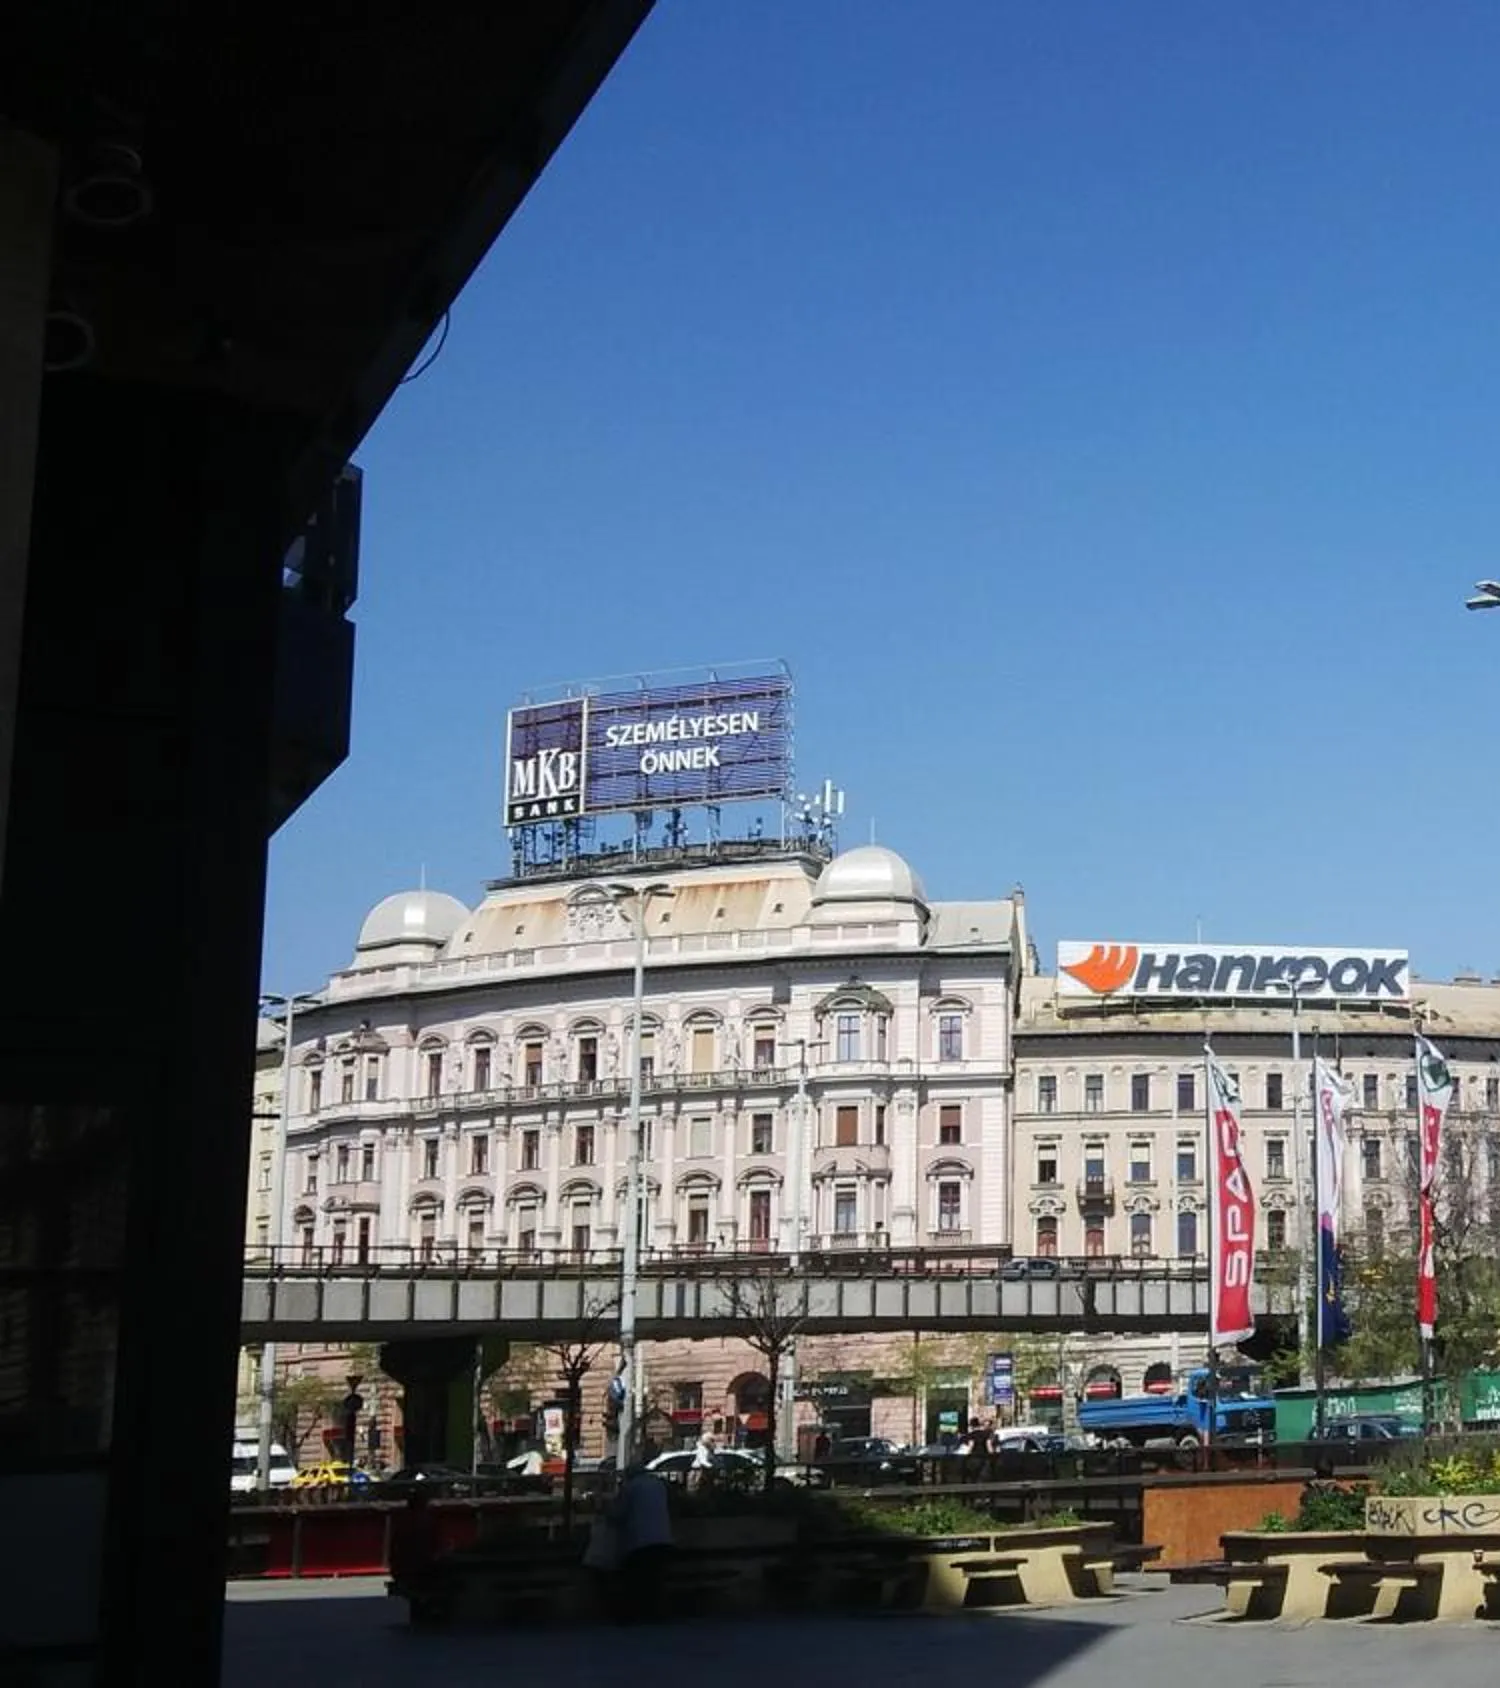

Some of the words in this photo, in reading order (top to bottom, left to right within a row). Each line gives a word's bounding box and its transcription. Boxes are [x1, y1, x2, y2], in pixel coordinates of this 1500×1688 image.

[606, 711, 758, 748] SZEMÉLYESEN
[512, 747, 576, 798] MKB
[640, 746, 720, 774] ÖNNEK
[513, 799, 575, 819] BANK
